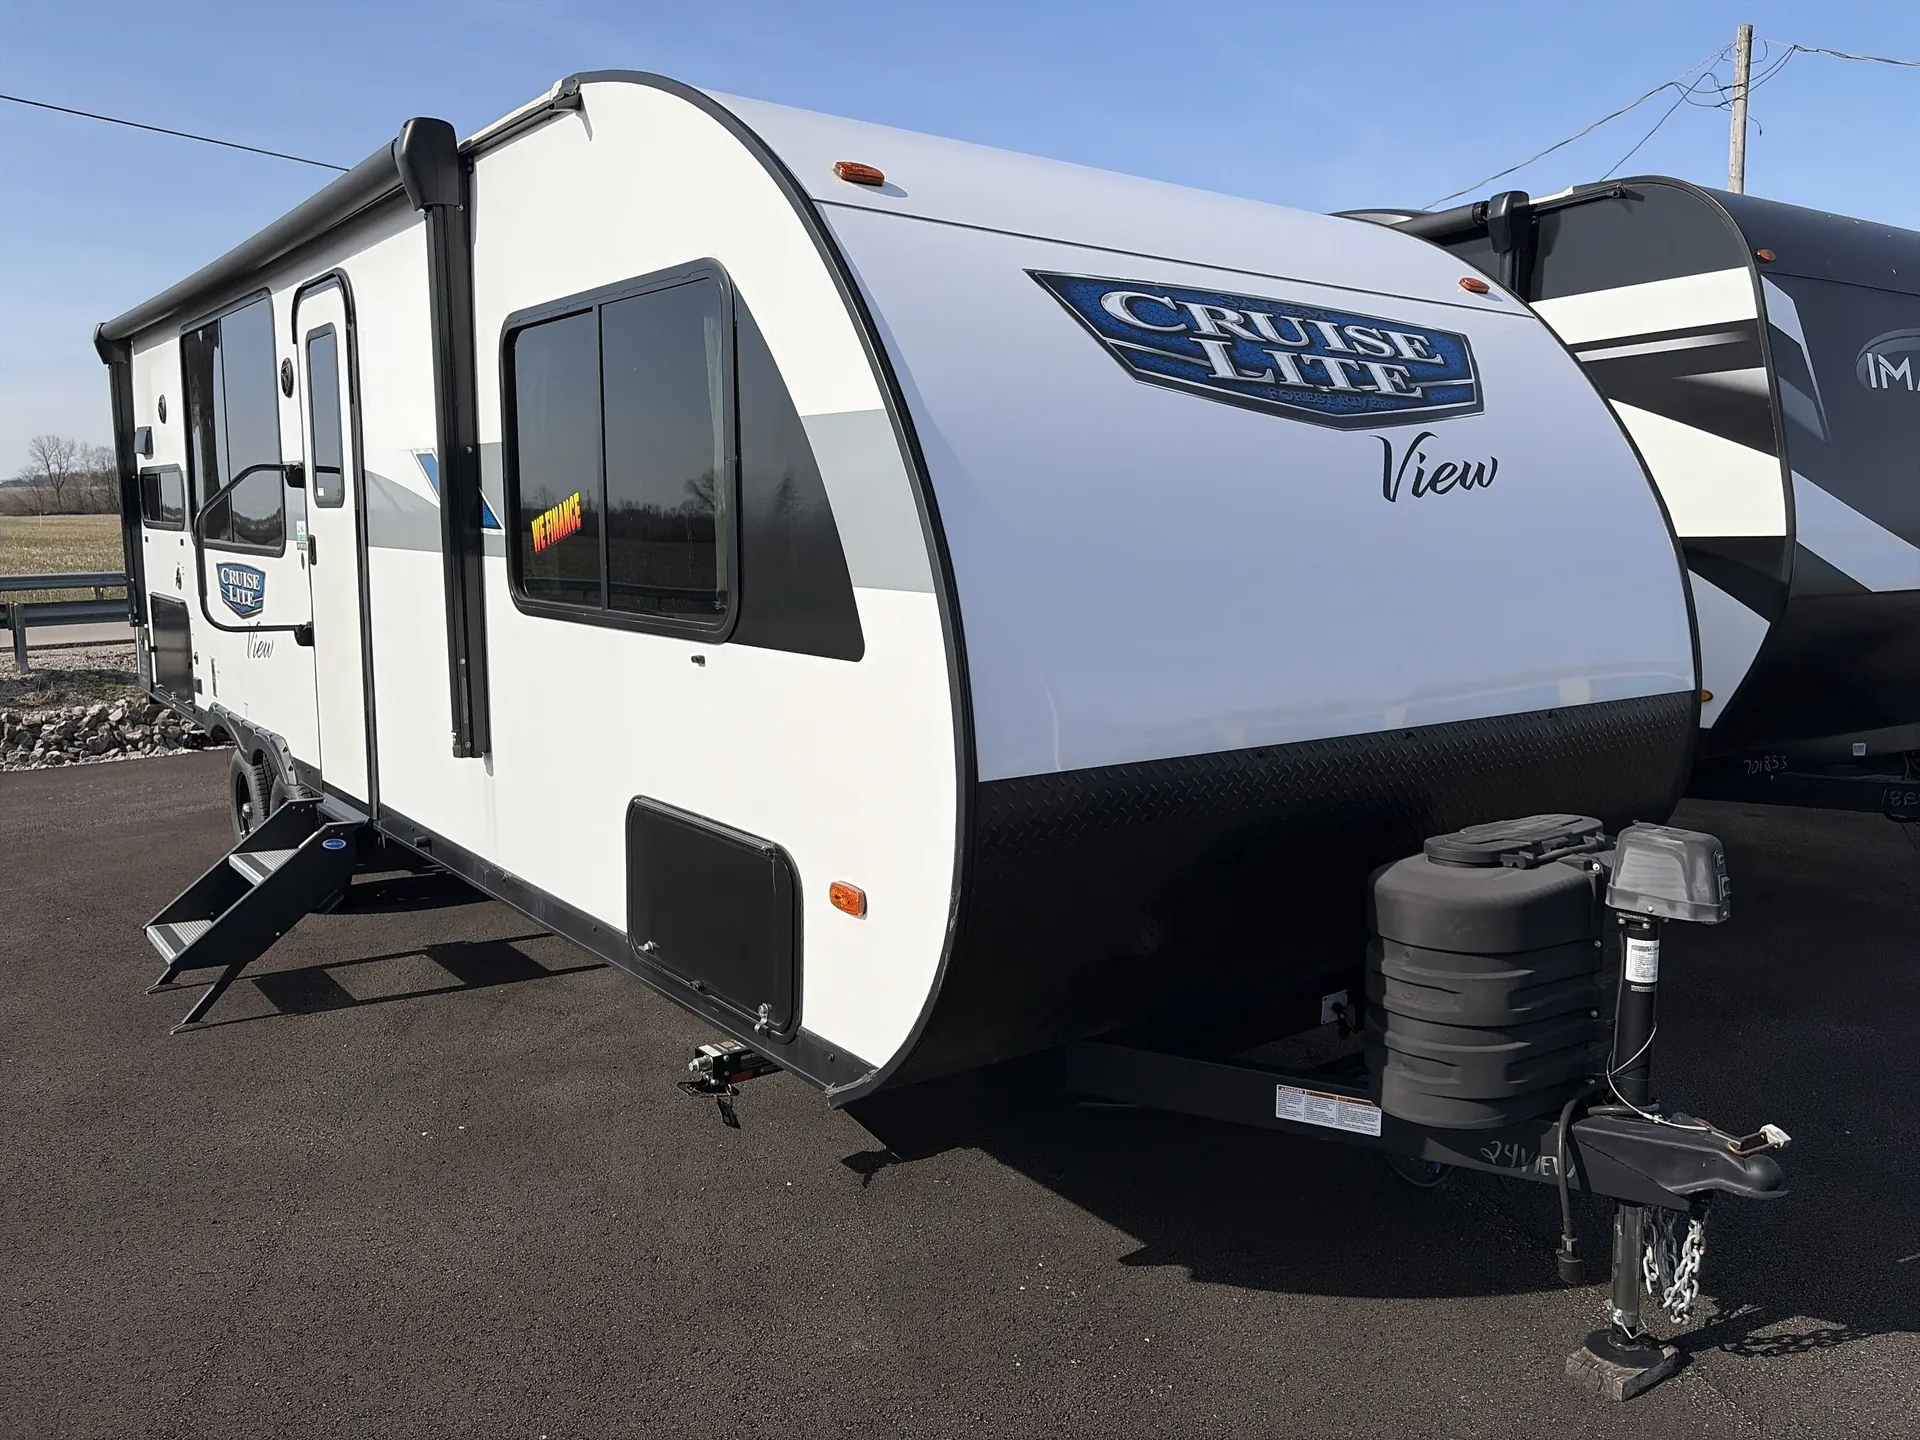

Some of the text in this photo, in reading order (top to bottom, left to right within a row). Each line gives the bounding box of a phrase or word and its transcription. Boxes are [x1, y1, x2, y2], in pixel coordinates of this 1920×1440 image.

[1100, 289, 1445, 365] CRUISE
[1190, 338, 1424, 399] LITE
[1866, 352, 1920, 392] IM
[1268, 387, 1392, 409] FOREST RIVER
[1370, 431, 1499, 502] View
[531, 491, 582, 553] WE FINANCE
[220, 567, 261, 590] CRUISE
[228, 585, 256, 607] LITE
[247, 621, 274, 659] View
[1743, 755, 1788, 775] 701853
